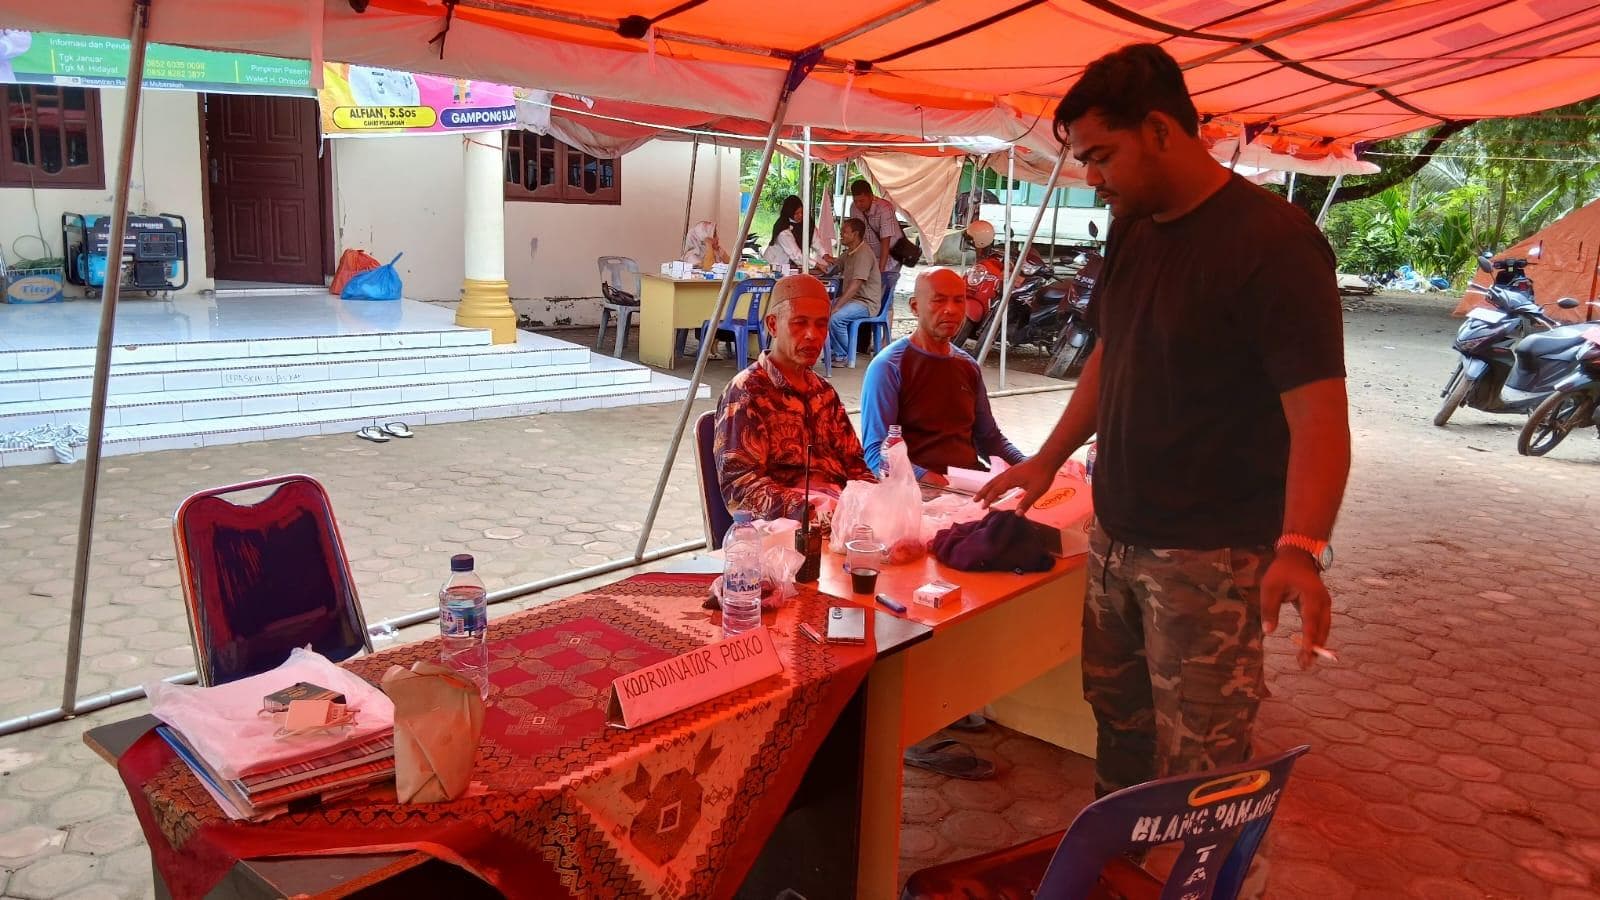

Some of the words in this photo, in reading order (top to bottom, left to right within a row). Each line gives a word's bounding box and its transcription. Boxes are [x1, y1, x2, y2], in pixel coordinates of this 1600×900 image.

[350, 108, 387, 120] ALFIAN,
[389, 107, 417, 118] S.Sos
[451, 111, 501, 124] GAMPONG
[622, 650, 718, 700] KOORDINATOR
[719, 635, 763, 666] POSKO
